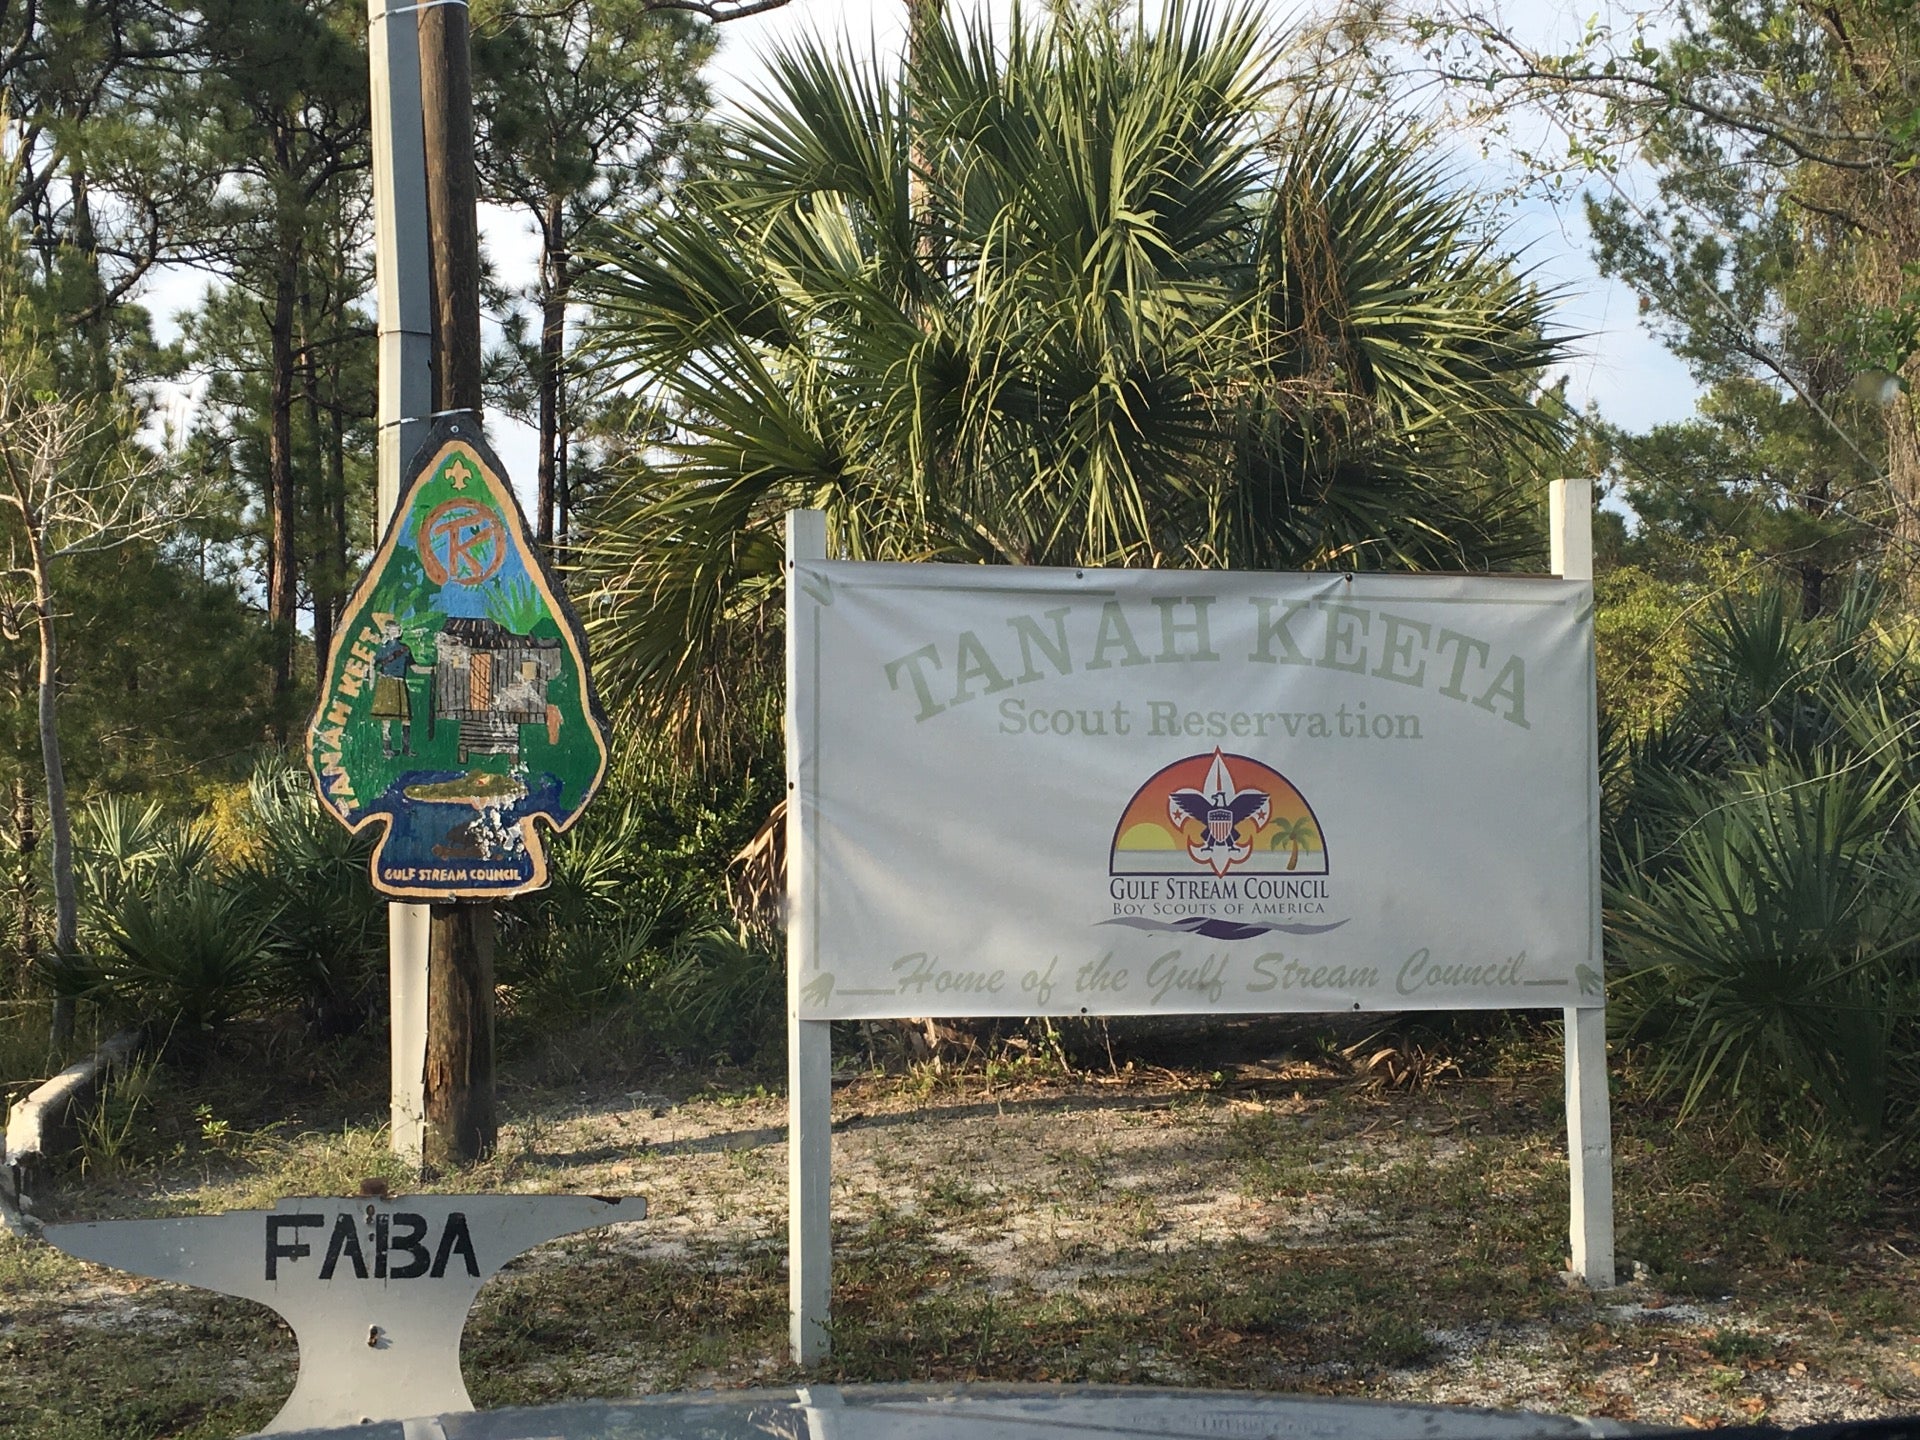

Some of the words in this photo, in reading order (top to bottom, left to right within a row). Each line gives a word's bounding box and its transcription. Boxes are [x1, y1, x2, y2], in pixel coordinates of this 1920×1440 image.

[884, 596, 1220, 724] TANAH
[1248, 596, 1531, 730] KEETA
[998, 698, 1131, 736] Scout
[1146, 700, 1424, 740] Reservation
[319, 700, 360, 818] TANAH
[384, 867, 416, 881] GULF
[418, 868, 468, 882] STREAM
[469, 868, 523, 881] COUNCIL
[1109, 878, 1160, 900] GULF
[1166, 878, 1237, 900] STREAM
[1243, 877, 1330, 899] COUNCIL
[1112, 902, 1146, 915] BOY
[1152, 902, 1217, 915] SCOUTS
[1223, 902, 1245, 915] OF
[1251, 902, 1325, 914] AMERICA
[891, 952, 1006, 995] Home
[1020, 955, 1057, 1006] of
[1075, 951, 1129, 994] the
[1145, 950, 1231, 1006] Gulf
[1245, 951, 1381, 993] Stream
[1395, 948, 1527, 996] Council
[265, 1212, 481, 1281] FABA
